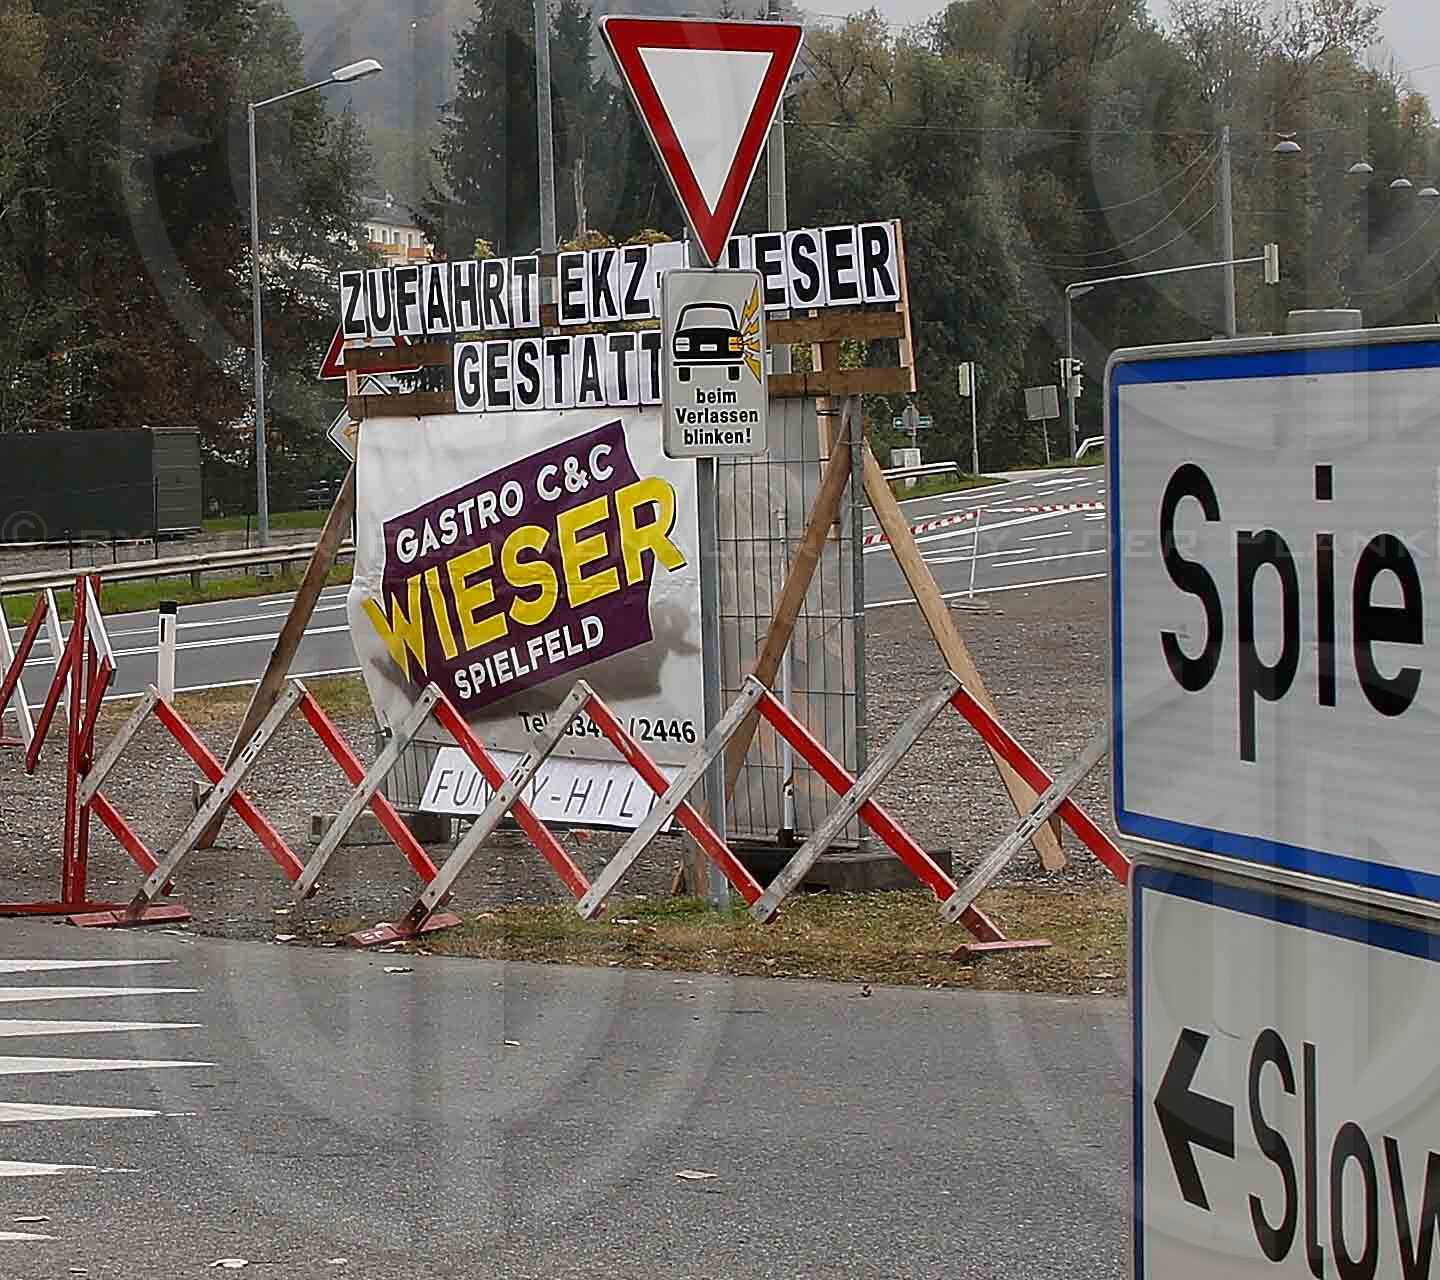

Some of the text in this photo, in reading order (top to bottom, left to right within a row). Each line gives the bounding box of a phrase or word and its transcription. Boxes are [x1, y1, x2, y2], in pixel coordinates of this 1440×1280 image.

[342, 259, 538, 335] ZUFAHRT
[675, 407, 759, 424] Verlassen
[696, 388, 737, 404] beim
[684, 427, 752, 445] blinken!
[395, 480, 524, 566] GASTRO
[536, 443, 615, 502] C&C
[361, 475, 688, 684] WIESER
[453, 615, 605, 700] SPIELFELD
